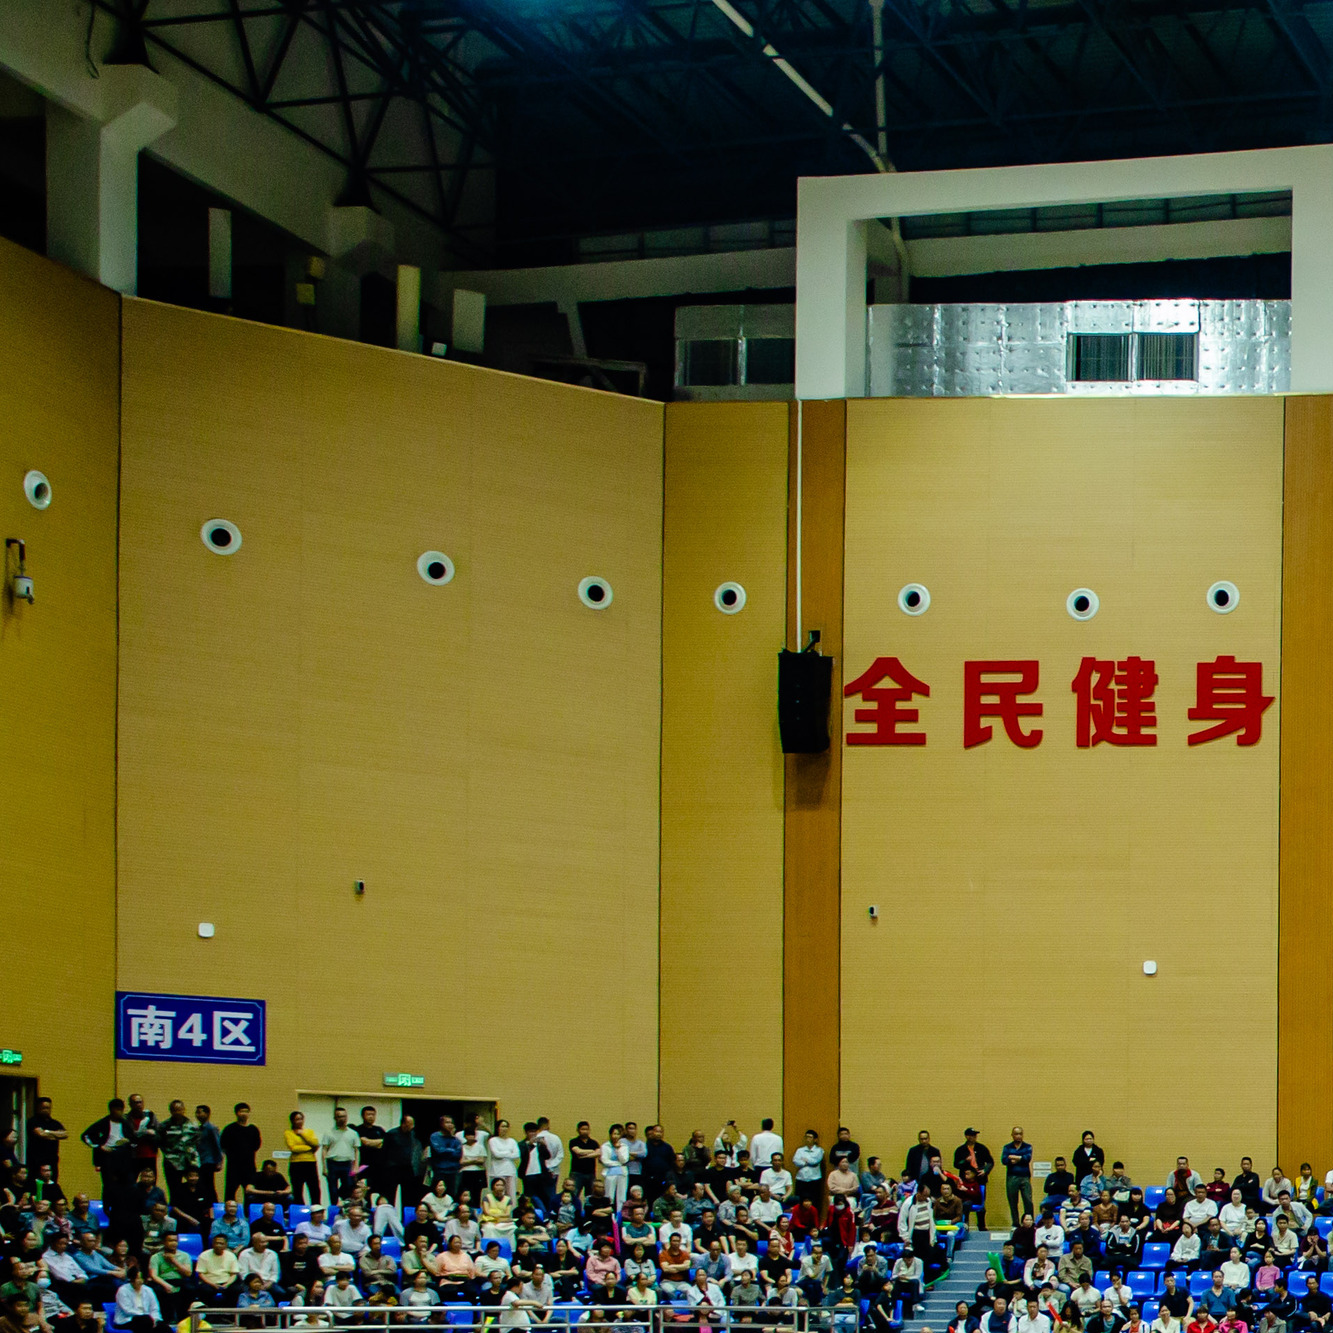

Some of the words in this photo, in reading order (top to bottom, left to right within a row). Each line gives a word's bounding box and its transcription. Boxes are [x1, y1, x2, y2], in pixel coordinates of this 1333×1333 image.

[843, 655, 1276, 750] 全民健身
[126, 1005, 256, 1052] 南4区
